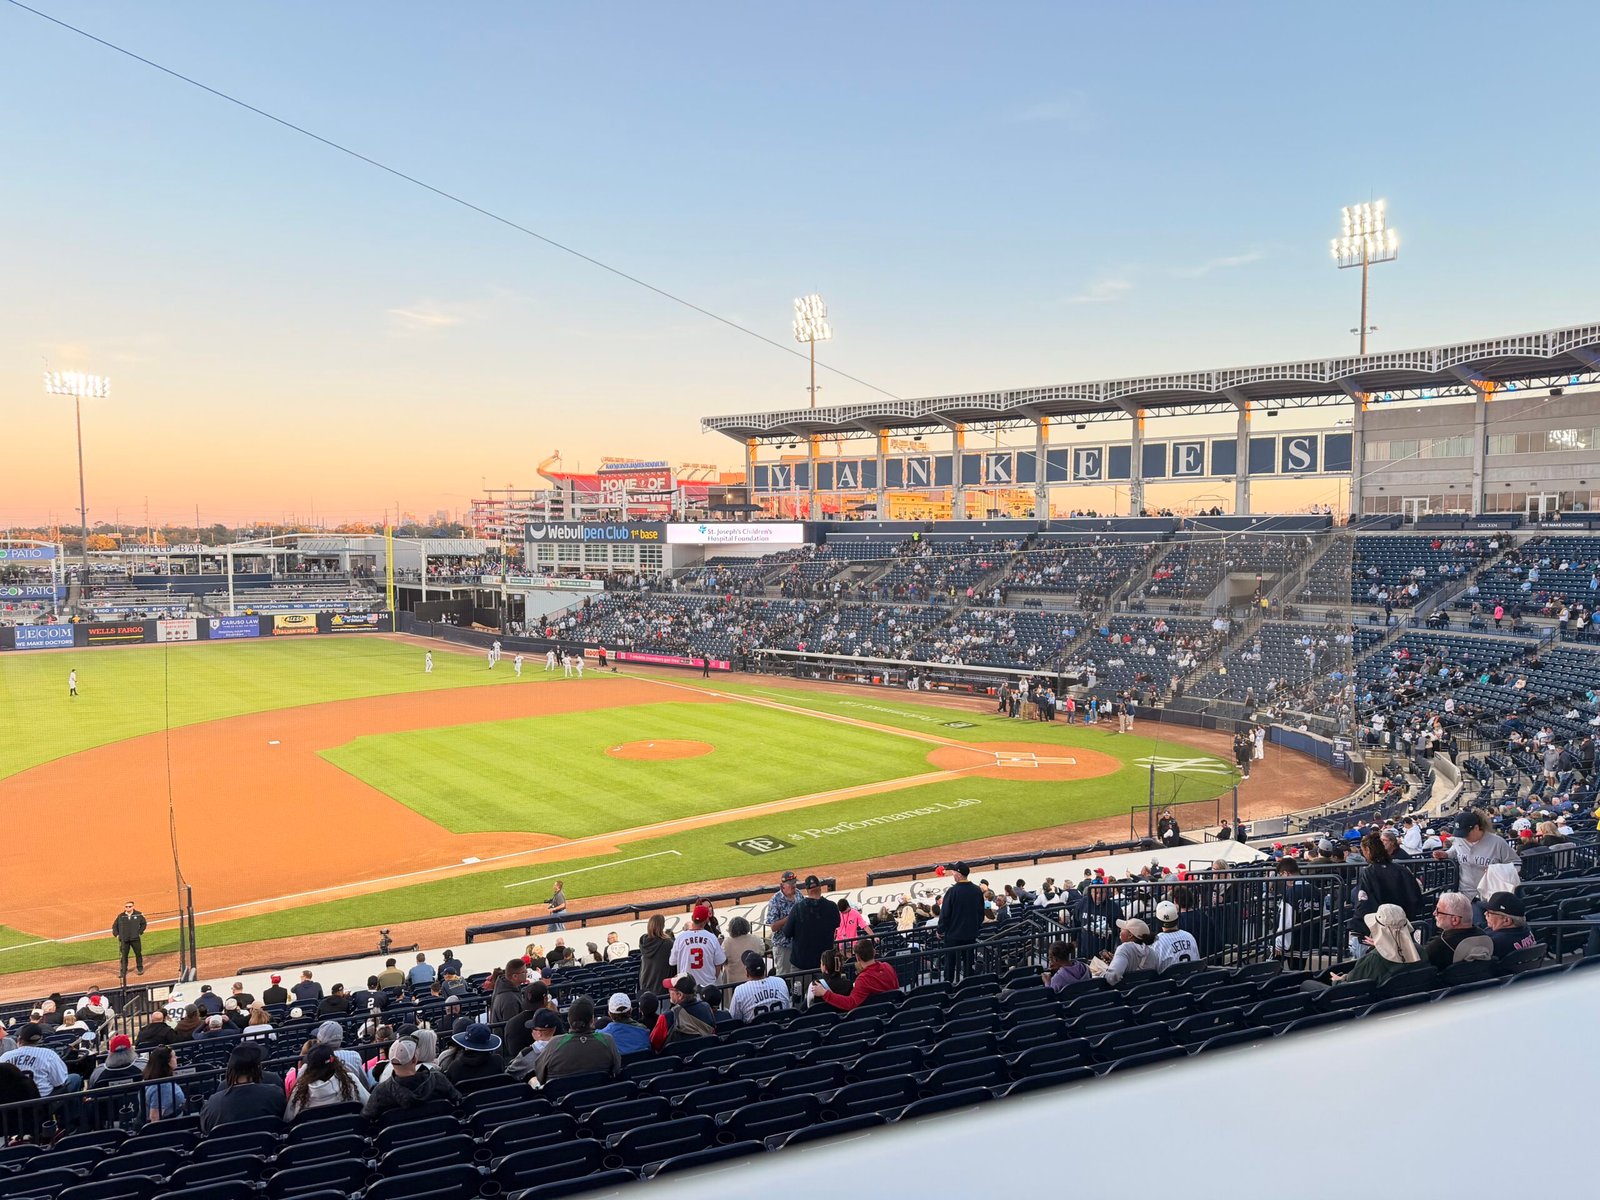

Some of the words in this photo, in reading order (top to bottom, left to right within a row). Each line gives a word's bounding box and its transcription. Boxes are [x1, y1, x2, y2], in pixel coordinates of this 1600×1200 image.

[771, 438, 1311, 490] YANKEES
[600, 479, 637, 491] HOME
[648, 477, 665, 490] OF
[548, 525, 604, 541] Webullpen
[606, 526, 629, 540] Club
[630, 530, 640, 540] 1st
[640, 529, 659, 540] base
[716, 528, 742, 538] Joseph's
[11, 550, 42, 558] PATIO
[120, 544, 173, 552] OUTFIELD
[179, 544, 204, 552] BAR
[26, 586, 54, 595] PATIO
[802, 808, 940, 839] Performance
[936, 798, 982, 810] Lab
[685, 936, 708, 946] CREWS
[1172, 940, 1191, 954] JETER
[690, 948, 704, 970] 3
[754, 988, 780, 1004] JUDGE
[368, 998, 374, 1008] 2
[168, 1008, 184, 1018] 99
